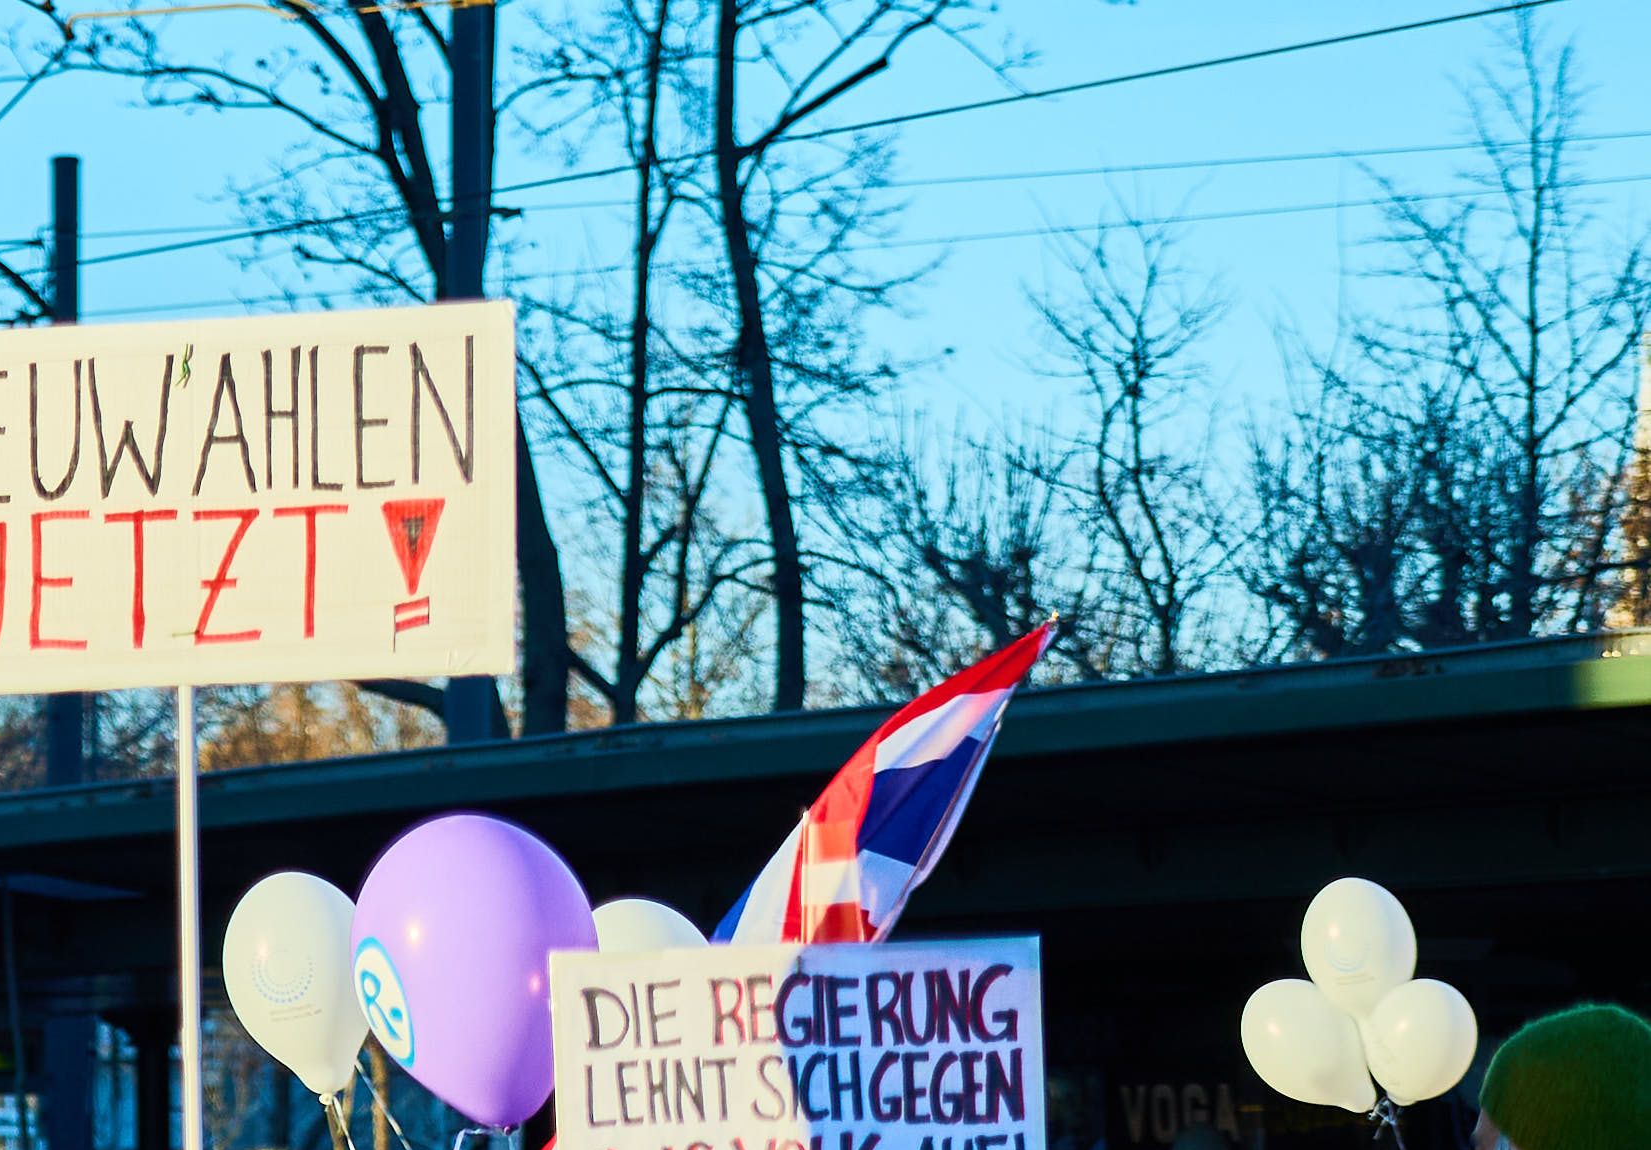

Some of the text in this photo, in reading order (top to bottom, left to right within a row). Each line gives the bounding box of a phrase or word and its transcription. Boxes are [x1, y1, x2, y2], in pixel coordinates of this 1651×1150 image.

[580, 963, 1018, 1051] DIE REGIERUNG
[586, 1056, 736, 1127] LEHNT
